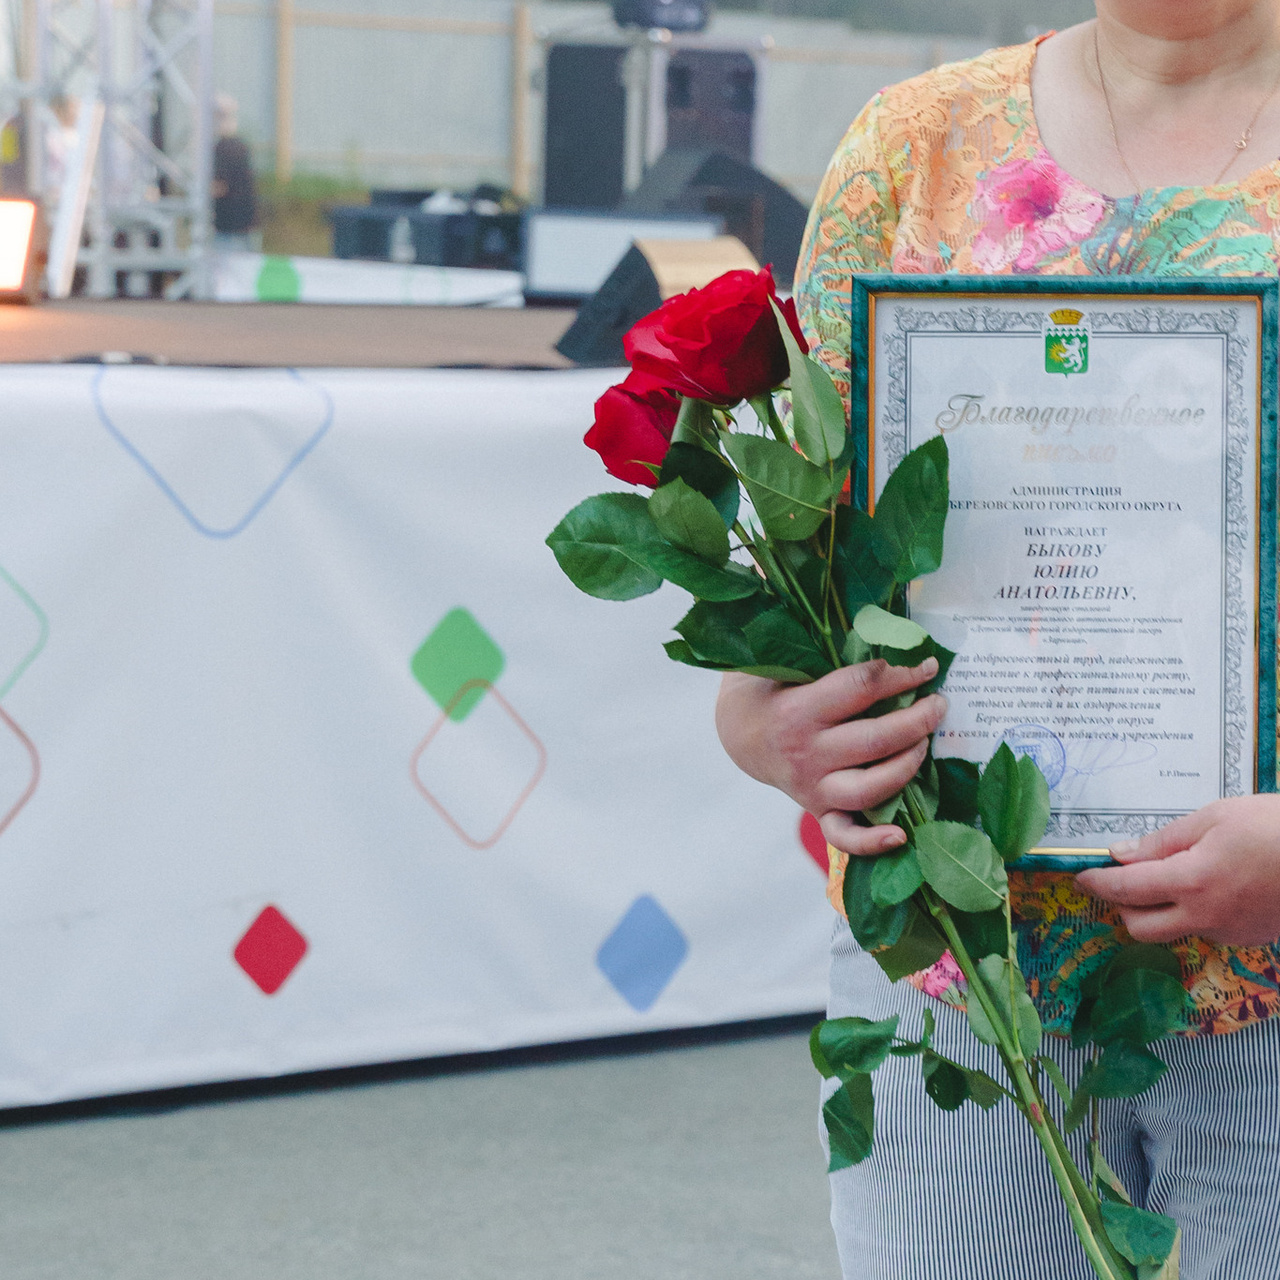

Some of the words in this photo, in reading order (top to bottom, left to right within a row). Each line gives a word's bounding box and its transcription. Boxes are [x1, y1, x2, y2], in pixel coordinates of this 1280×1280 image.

[935, 393, 1206, 435] Благодарственное
[1009, 486, 1123, 497] АДМИНИСТРАЦИЯ
[949, 499, 1047, 512] БЕРЕЗОВСКОГО
[1049, 500, 1132, 512] ГОРОДСКОГО
[1134, 501, 1183, 512] ОКРУГА
[1024, 526, 1109, 538] НАГРАЖДАЕТ
[1026, 543, 1108, 559] БЫКОВУ
[1033, 564, 1100, 579] ЮЛИЮ
[993, 585, 1137, 602] АНАТОЛЬЕВНУ,
[957, 654, 970, 664] за
[972, 652, 1070, 666] добросовестный
[1072, 653, 1105, 667] труд,
[1108, 654, 1184, 665] надежность
[949, 669, 1021, 681] стремление
[1023, 670, 1031, 678] к
[1033, 668, 1150, 682] профессиональному
[1152, 671, 1191, 683] росту,
[983, 684, 1039, 694] качество
[1041, 685, 1048, 694] в
[1050, 683, 1085, 696] сфере
[1086, 686, 1139, 695] питания
[1142, 687, 1196, 696] системы
[967, 698, 1014, 709] отдыха
[1017, 698, 1053, 709] детей
[1056, 701, 1063, 709] и
[1066, 700, 1080, 709] их
[1083, 699, 1161, 712] оздоровления
[975, 712, 1050, 725] Березовского
[1052, 714, 1114, 727] городского
[1117, 716, 1155, 728] округа
[938, 729, 946, 738] и
[948, 729, 955, 738] в
[958, 729, 990, 738] связи
[992, 730, 1000, 738] с
[1068, 729, 1119, 740] юбилеем
[1120, 729, 1194, 743] учреждения
